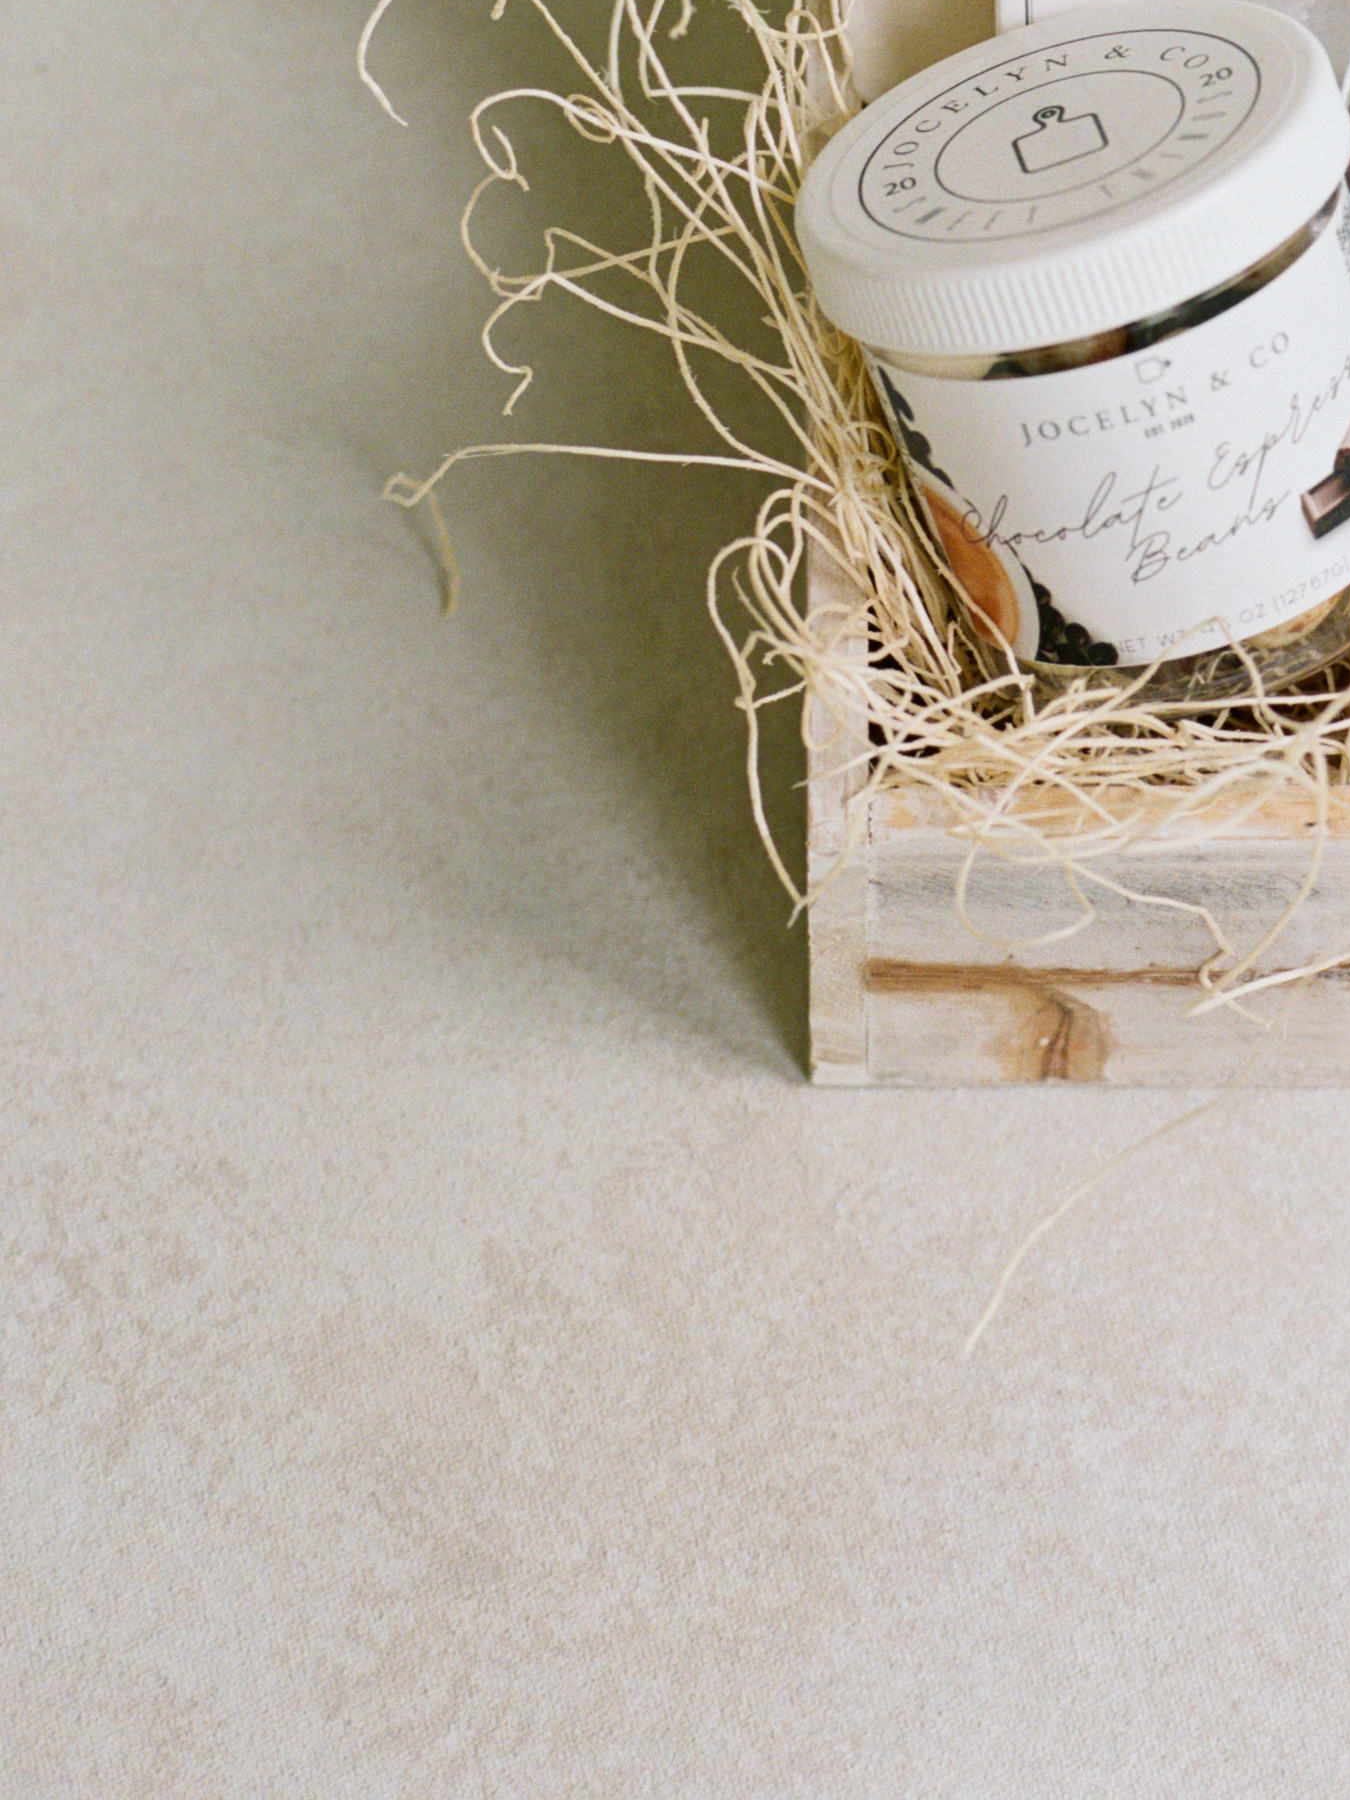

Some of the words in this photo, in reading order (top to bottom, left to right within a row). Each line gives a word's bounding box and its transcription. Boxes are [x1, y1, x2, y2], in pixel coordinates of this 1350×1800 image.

[883, 54, 1069, 170] JOCELYN
[1104, 44, 1131, 60] &
[1159, 45, 1211, 69] CO
[1021, 384, 1190, 447] JOCELYN
[1210, 369, 1231, 392] &
[1249, 331, 1290, 369] CO
[961, 464, 1183, 548] Chocolate
[1125, 489, 1291, 584] Beans
[1239, 602, 1268, 624] OZ
